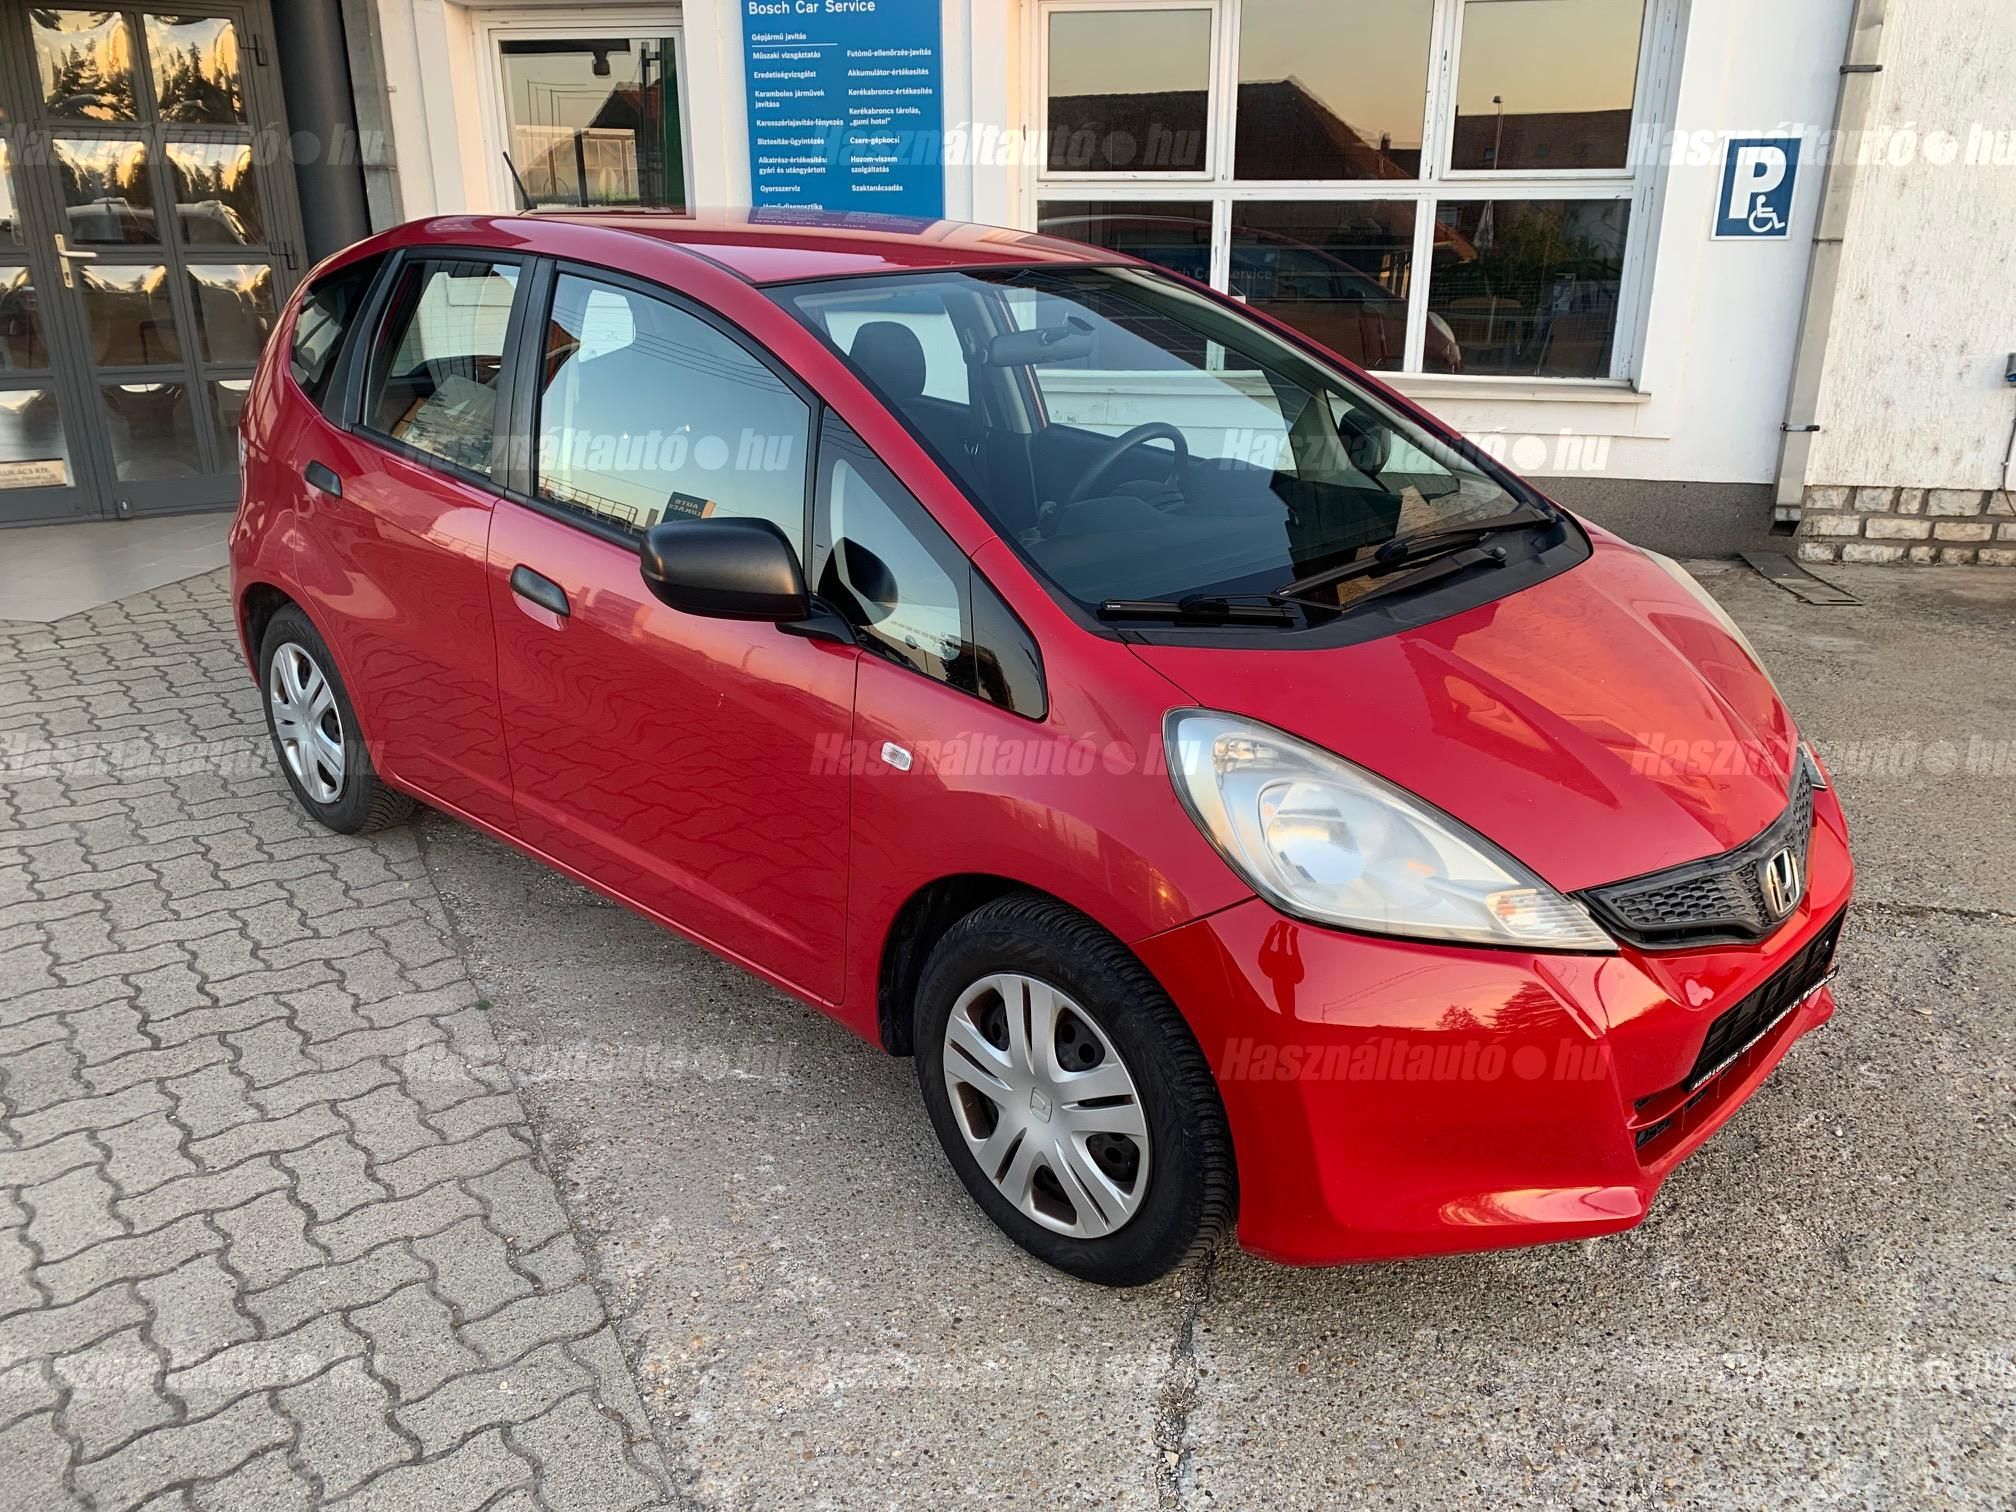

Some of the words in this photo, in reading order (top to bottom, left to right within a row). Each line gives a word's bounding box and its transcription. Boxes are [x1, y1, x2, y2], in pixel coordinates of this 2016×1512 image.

[748, 1, 790, 15] Bosch
[795, 1, 819, 13] Car
[825, 0, 876, 12] Service
[753, 70, 817, 80] Eredetiségvizsgálat
[847, 67, 929, 77] Akkumulátor-értékesítés
[754, 90, 794, 98] Karambolos
[848, 87, 933, 96] Kerékabroncs-értékesítés
[849, 107, 894, 115] Kerékabroncs
[849, 136, 900, 145] Csere-gépkocsi
[850, 155, 898, 163] Hozom-viszem
[785, 167, 826, 175] utángyártott
[851, 166, 890, 174] szolgáltatás
[1729, 146, 1787, 219] P
[760, 185, 801, 193] Gyorsszerviz
[851, 184, 904, 192] Szaktanácsadás
